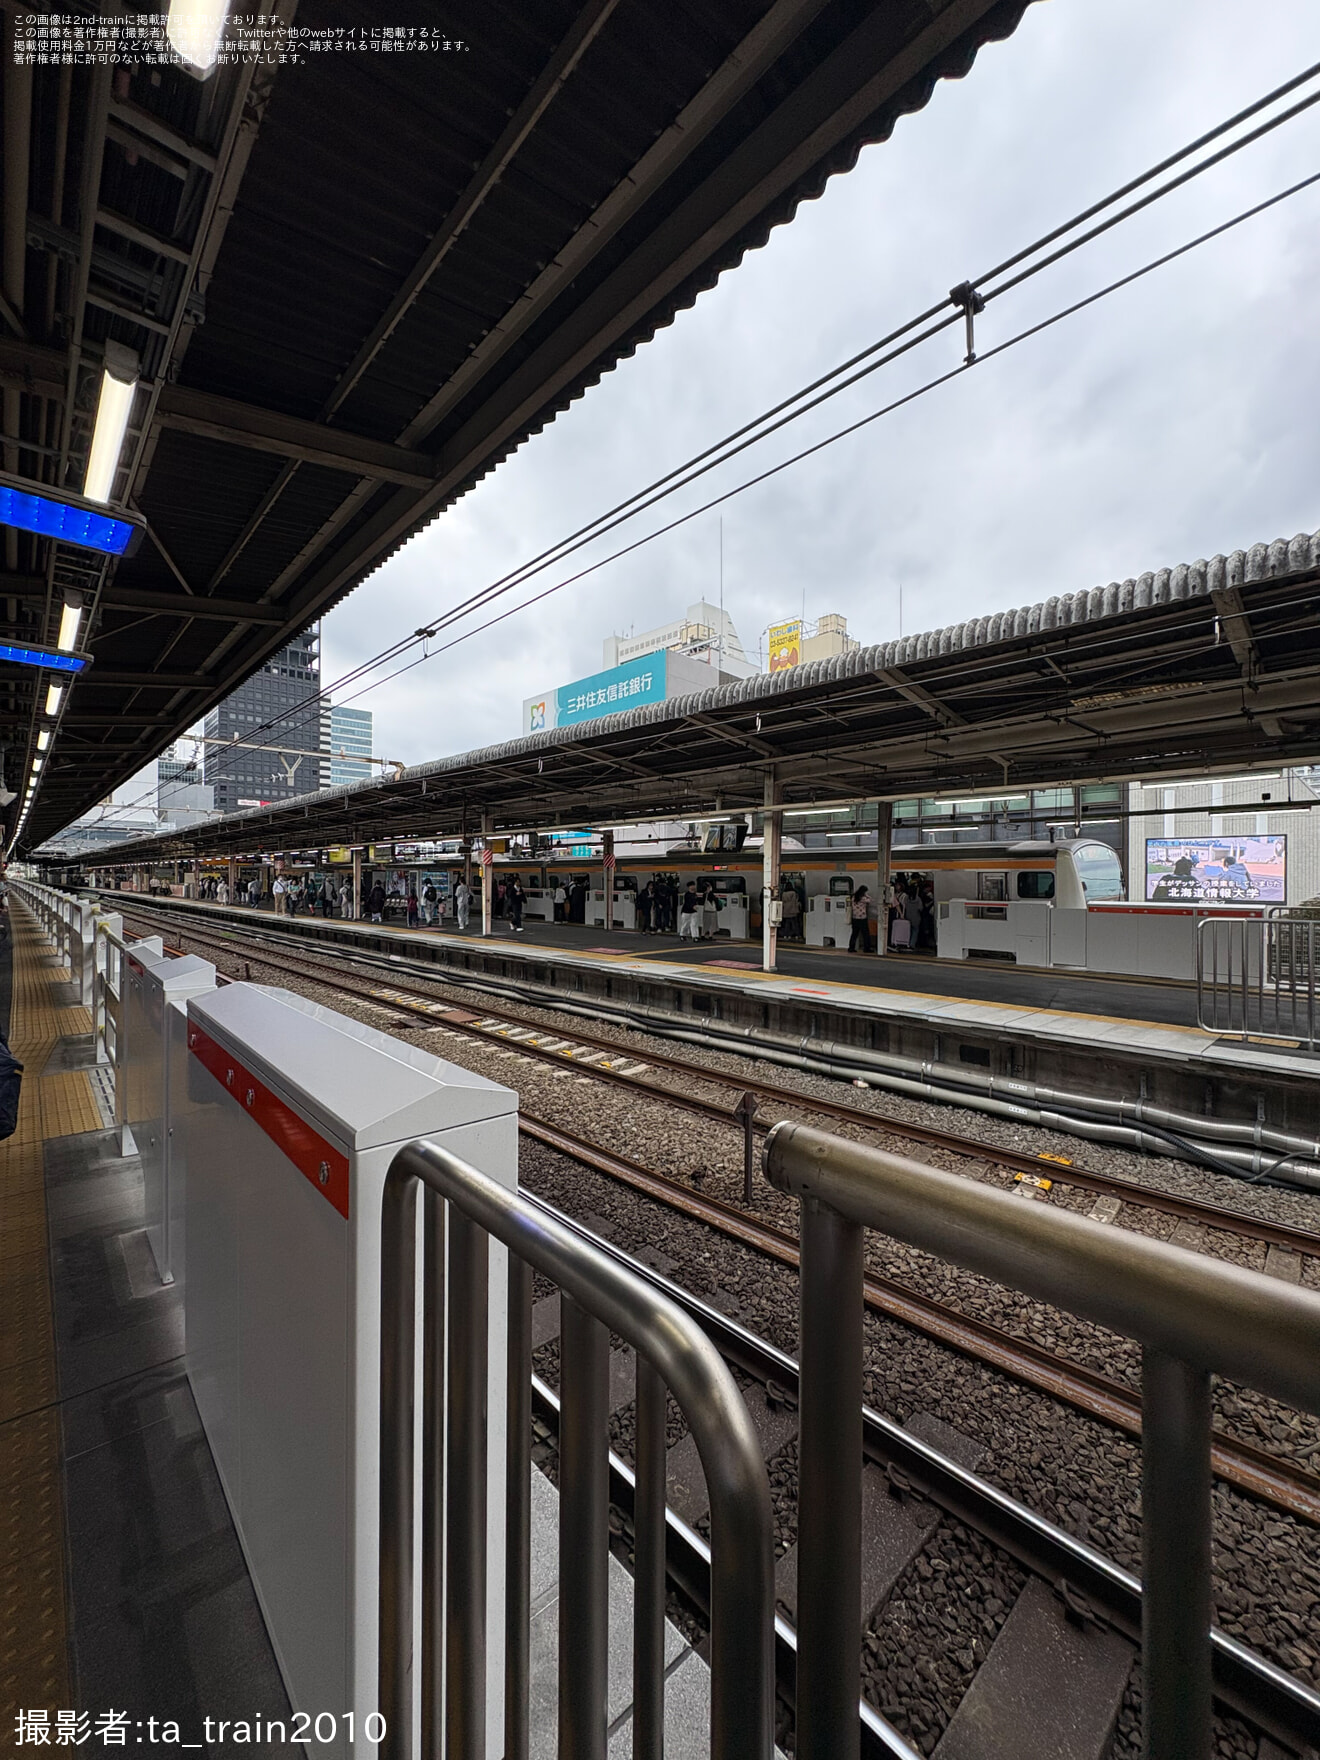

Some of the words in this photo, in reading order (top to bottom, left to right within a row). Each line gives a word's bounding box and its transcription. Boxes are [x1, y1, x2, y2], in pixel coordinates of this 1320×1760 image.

[567, 672, 653, 714] 三井住友信託銀行
[1168, 886, 1260, 899] 北海道情報大学
